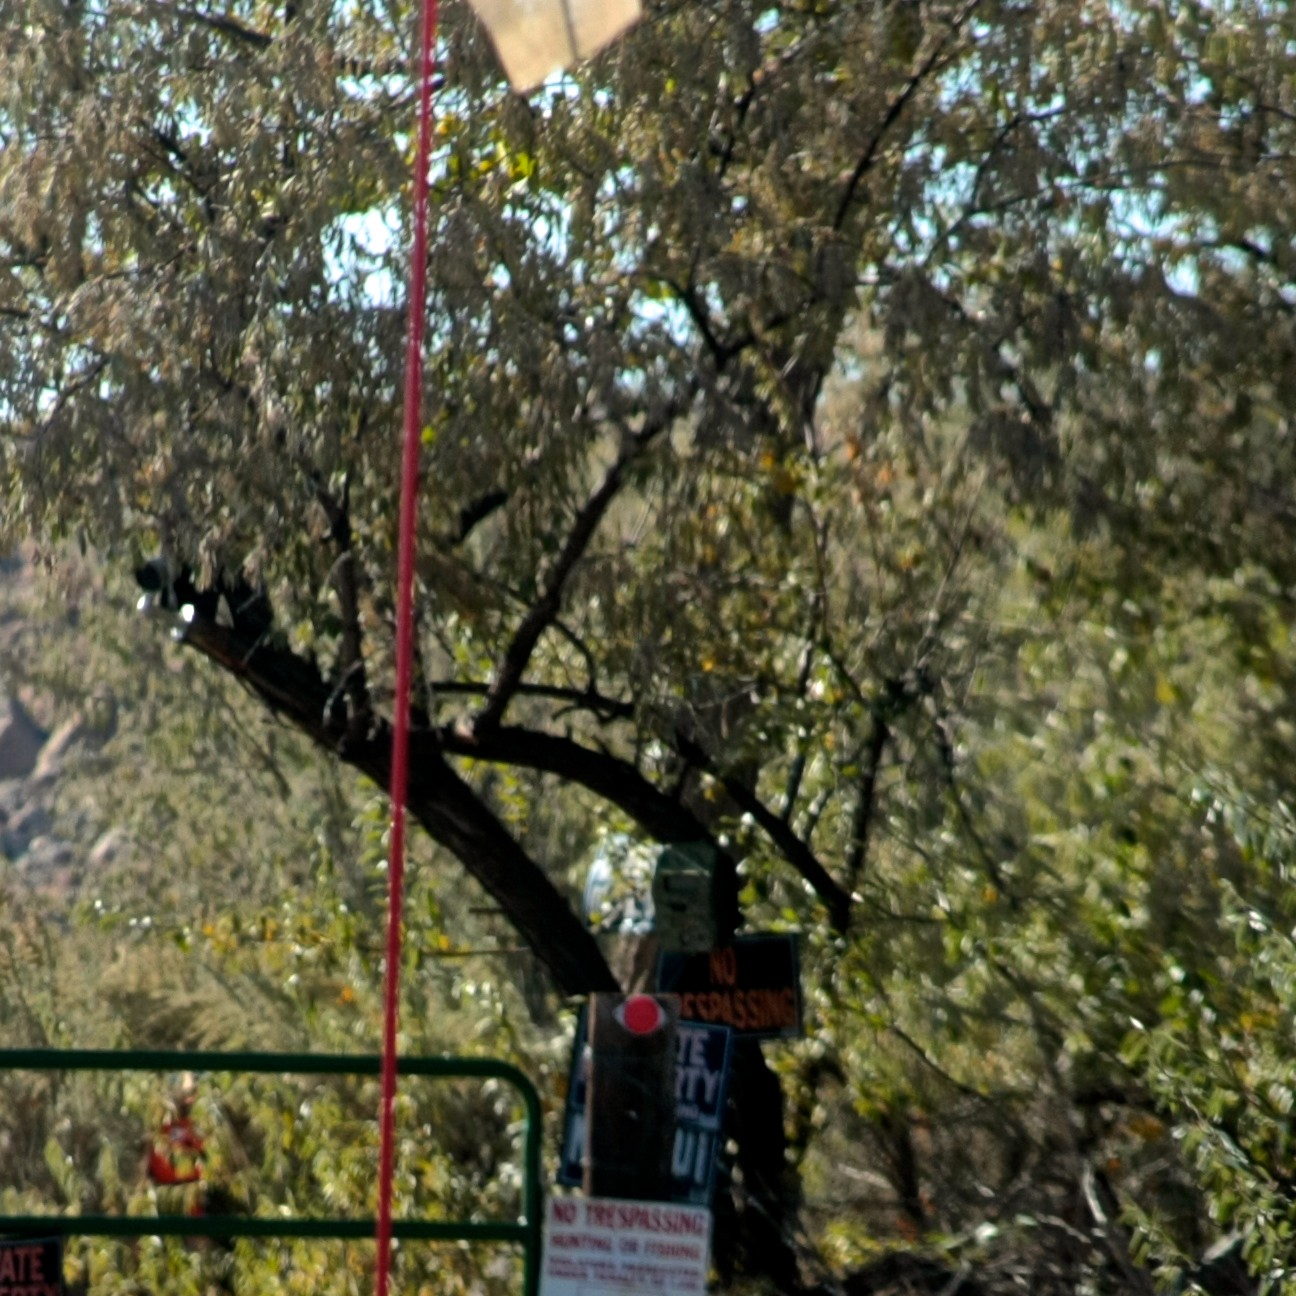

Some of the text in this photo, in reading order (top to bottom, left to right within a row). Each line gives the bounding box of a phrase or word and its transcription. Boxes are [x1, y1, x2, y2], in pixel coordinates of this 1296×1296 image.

[680, 985, 796, 1030] ESPASSING
[553, 1202, 704, 1235] NO TRESPASSING
